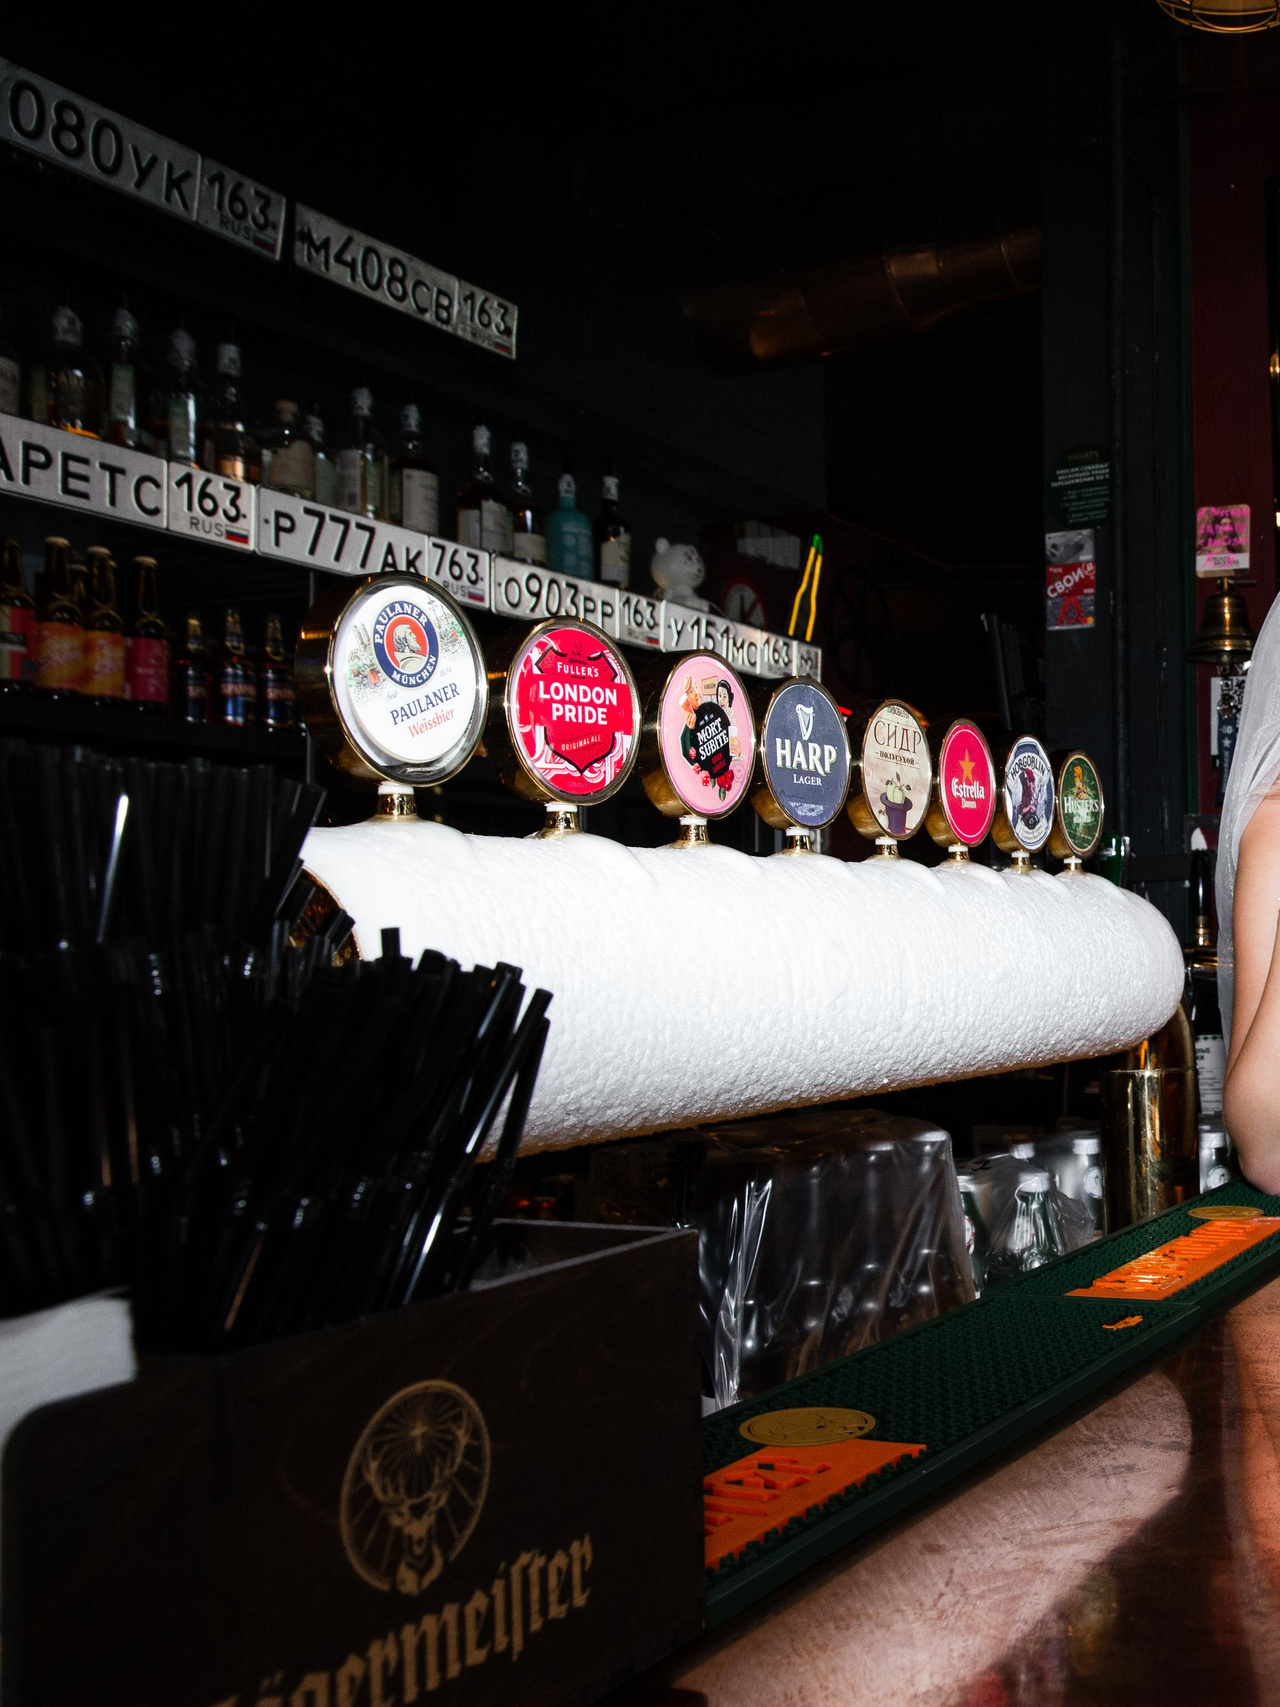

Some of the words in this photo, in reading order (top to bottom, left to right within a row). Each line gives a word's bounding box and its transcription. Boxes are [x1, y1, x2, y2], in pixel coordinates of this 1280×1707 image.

[206, 173, 270, 231] 163
[219, 215, 251, 241] RUS
[463, 291, 509, 335] 163
[175, 472, 241, 523] 163
[189, 516, 225, 538] RUS
[432, 542, 479, 586] 763
[374, 601, 428, 645] PAULANER
[622, 595, 657, 630] 163
[762, 635, 791, 668] 163
[391, 654, 437, 686] MÜNCHEN
[389, 682, 461, 726] PAULANER
[538, 680, 618, 706] LONDON
[407, 708, 456, 739] Weissbier
[551, 702, 609, 726] PRIDE
[561, 738, 591, 752] ORIGINAL
[590, 734, 602, 745] ALE
[696, 717, 723, 746] MORT
[698, 729, 729, 761] SUBITE
[873, 720, 921, 755] СИДР
[775, 737, 837, 777] HARP
[1010, 754, 1046, 781] HOBGOBLIN
[793, 773, 823, 786] LAGER
[951, 776, 985, 800] Estrella
